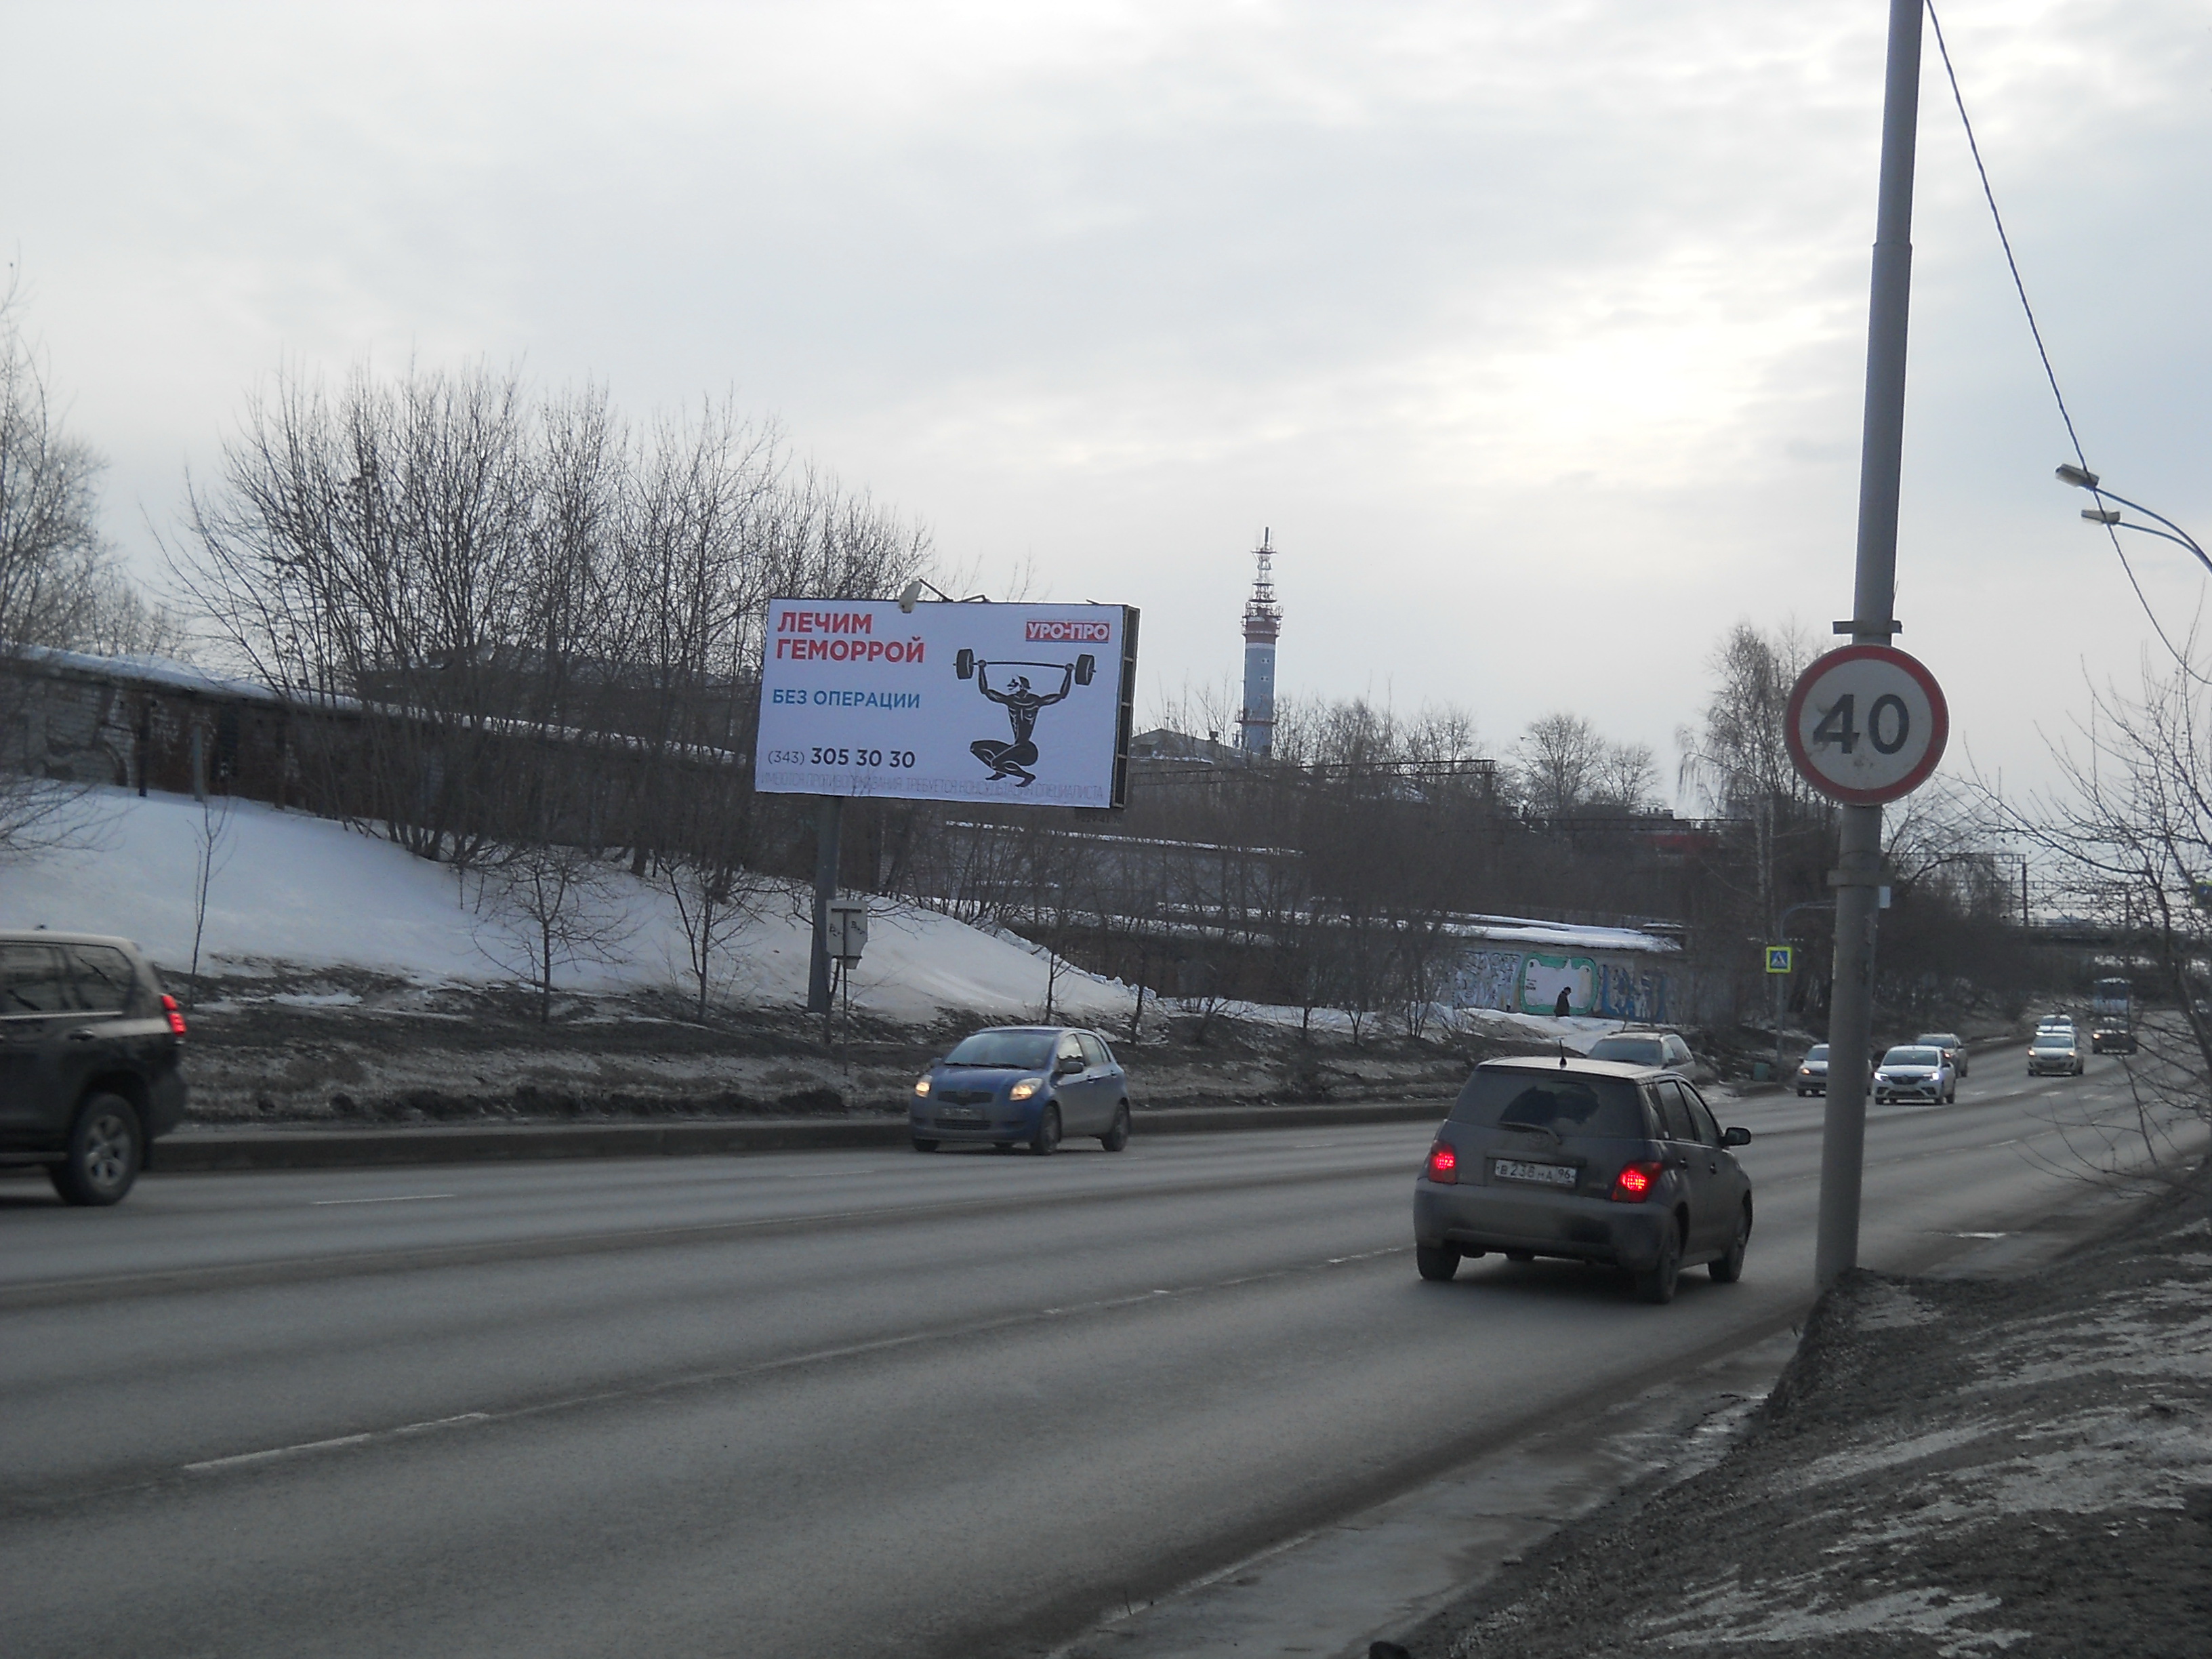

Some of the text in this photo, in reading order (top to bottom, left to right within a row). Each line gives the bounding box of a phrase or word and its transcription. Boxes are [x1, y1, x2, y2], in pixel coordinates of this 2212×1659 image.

[777, 611, 872, 634] ЛЕЧИМ
[1027, 622, 1109, 640] УРО-ПРО
[777, 636, 924, 663] ГЕМОРРОЙ
[773, 689, 920, 711] БЕЗ ОПЕРАЦИИ
[1812, 693, 1910, 755] 40
[768, 747, 916, 769] (343) 305 30 30
